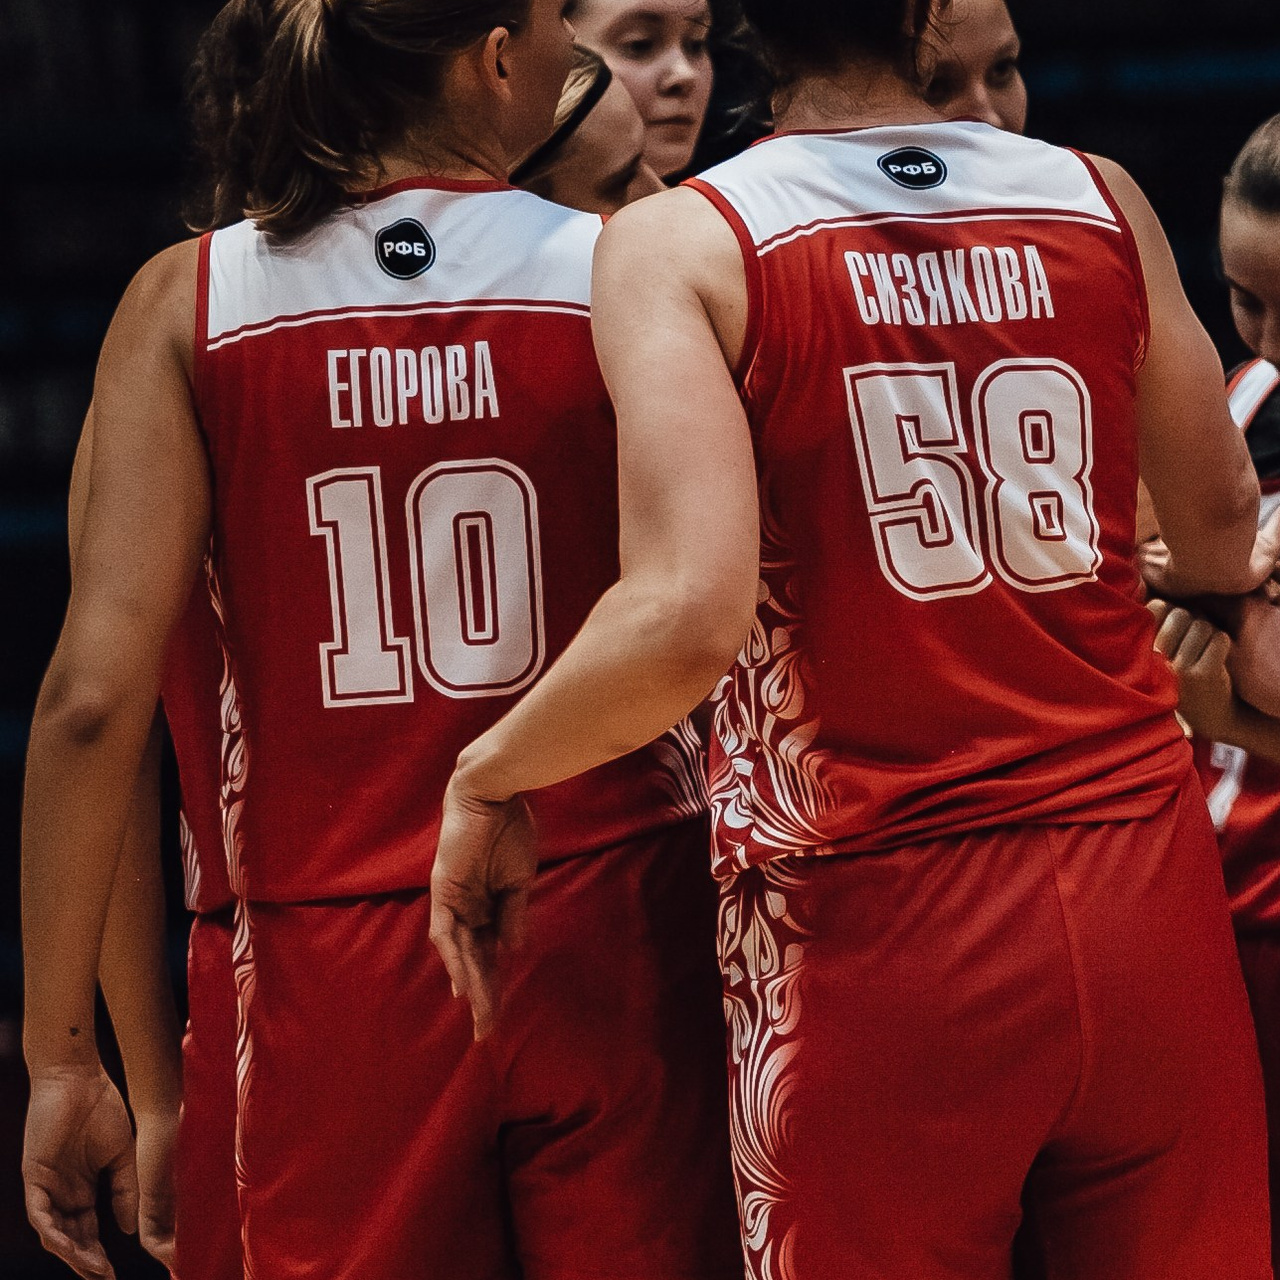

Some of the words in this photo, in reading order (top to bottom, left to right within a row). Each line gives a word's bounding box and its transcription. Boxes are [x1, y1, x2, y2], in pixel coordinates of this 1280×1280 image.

[888, 161, 937, 175] РФБ
[383, 240, 427, 258] РФБ
[843, 245, 1055, 326] СИЗЯКОВА
[327, 340, 500, 429] ЕГОРОВА
[842, 357, 1103, 602] 58
[305, 457, 546, 709] 10
